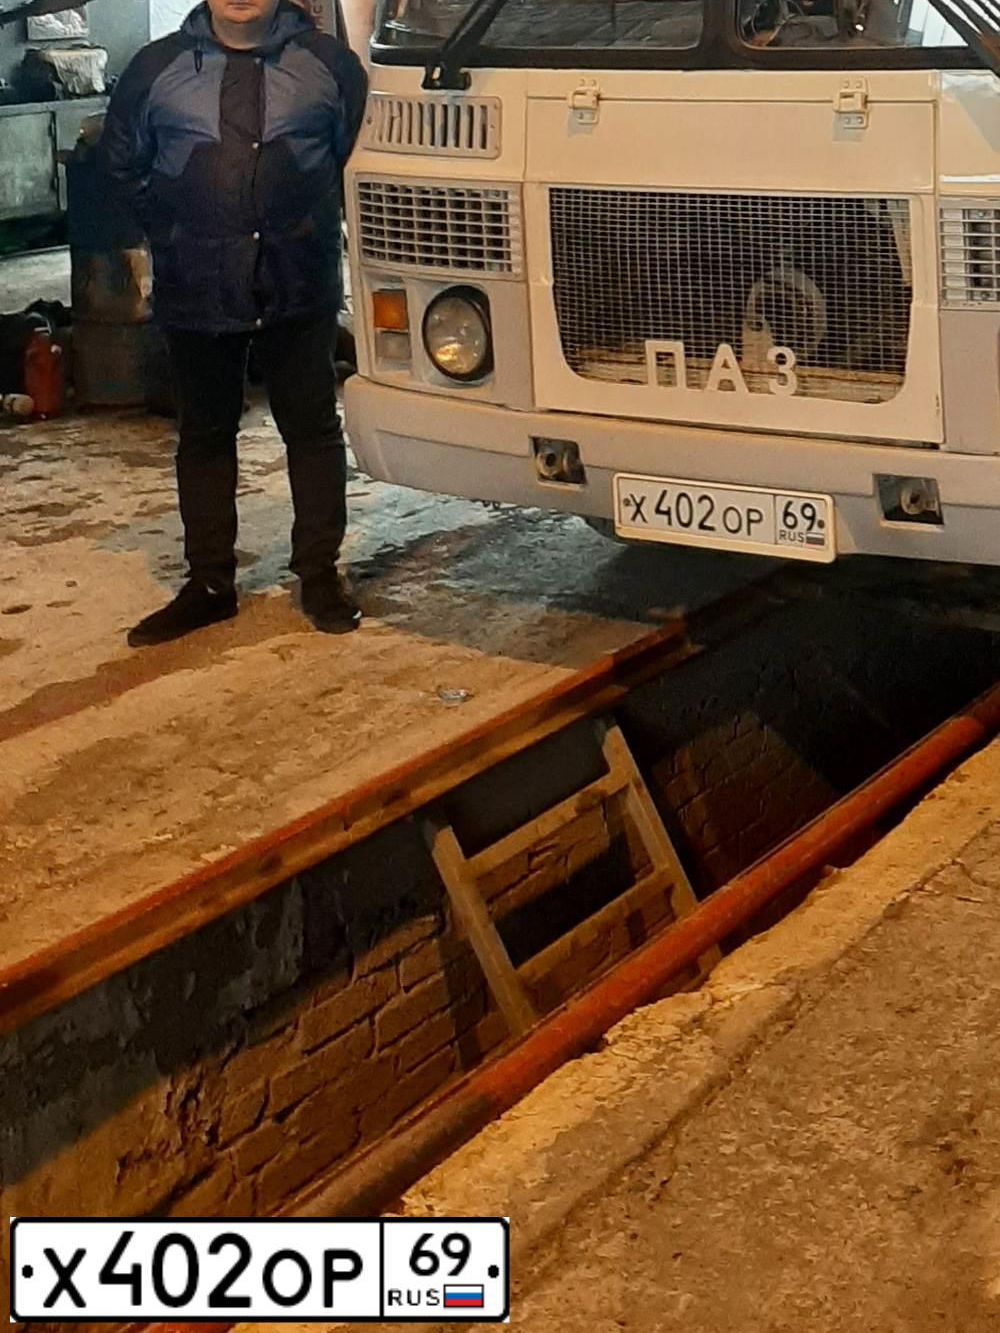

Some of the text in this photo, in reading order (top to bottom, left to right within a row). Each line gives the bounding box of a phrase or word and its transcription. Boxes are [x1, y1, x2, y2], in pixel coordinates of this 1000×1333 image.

[645, 340, 798, 396] ПАЗ
[782, 500, 817, 531] 69
[779, 529, 805, 543] RUS
